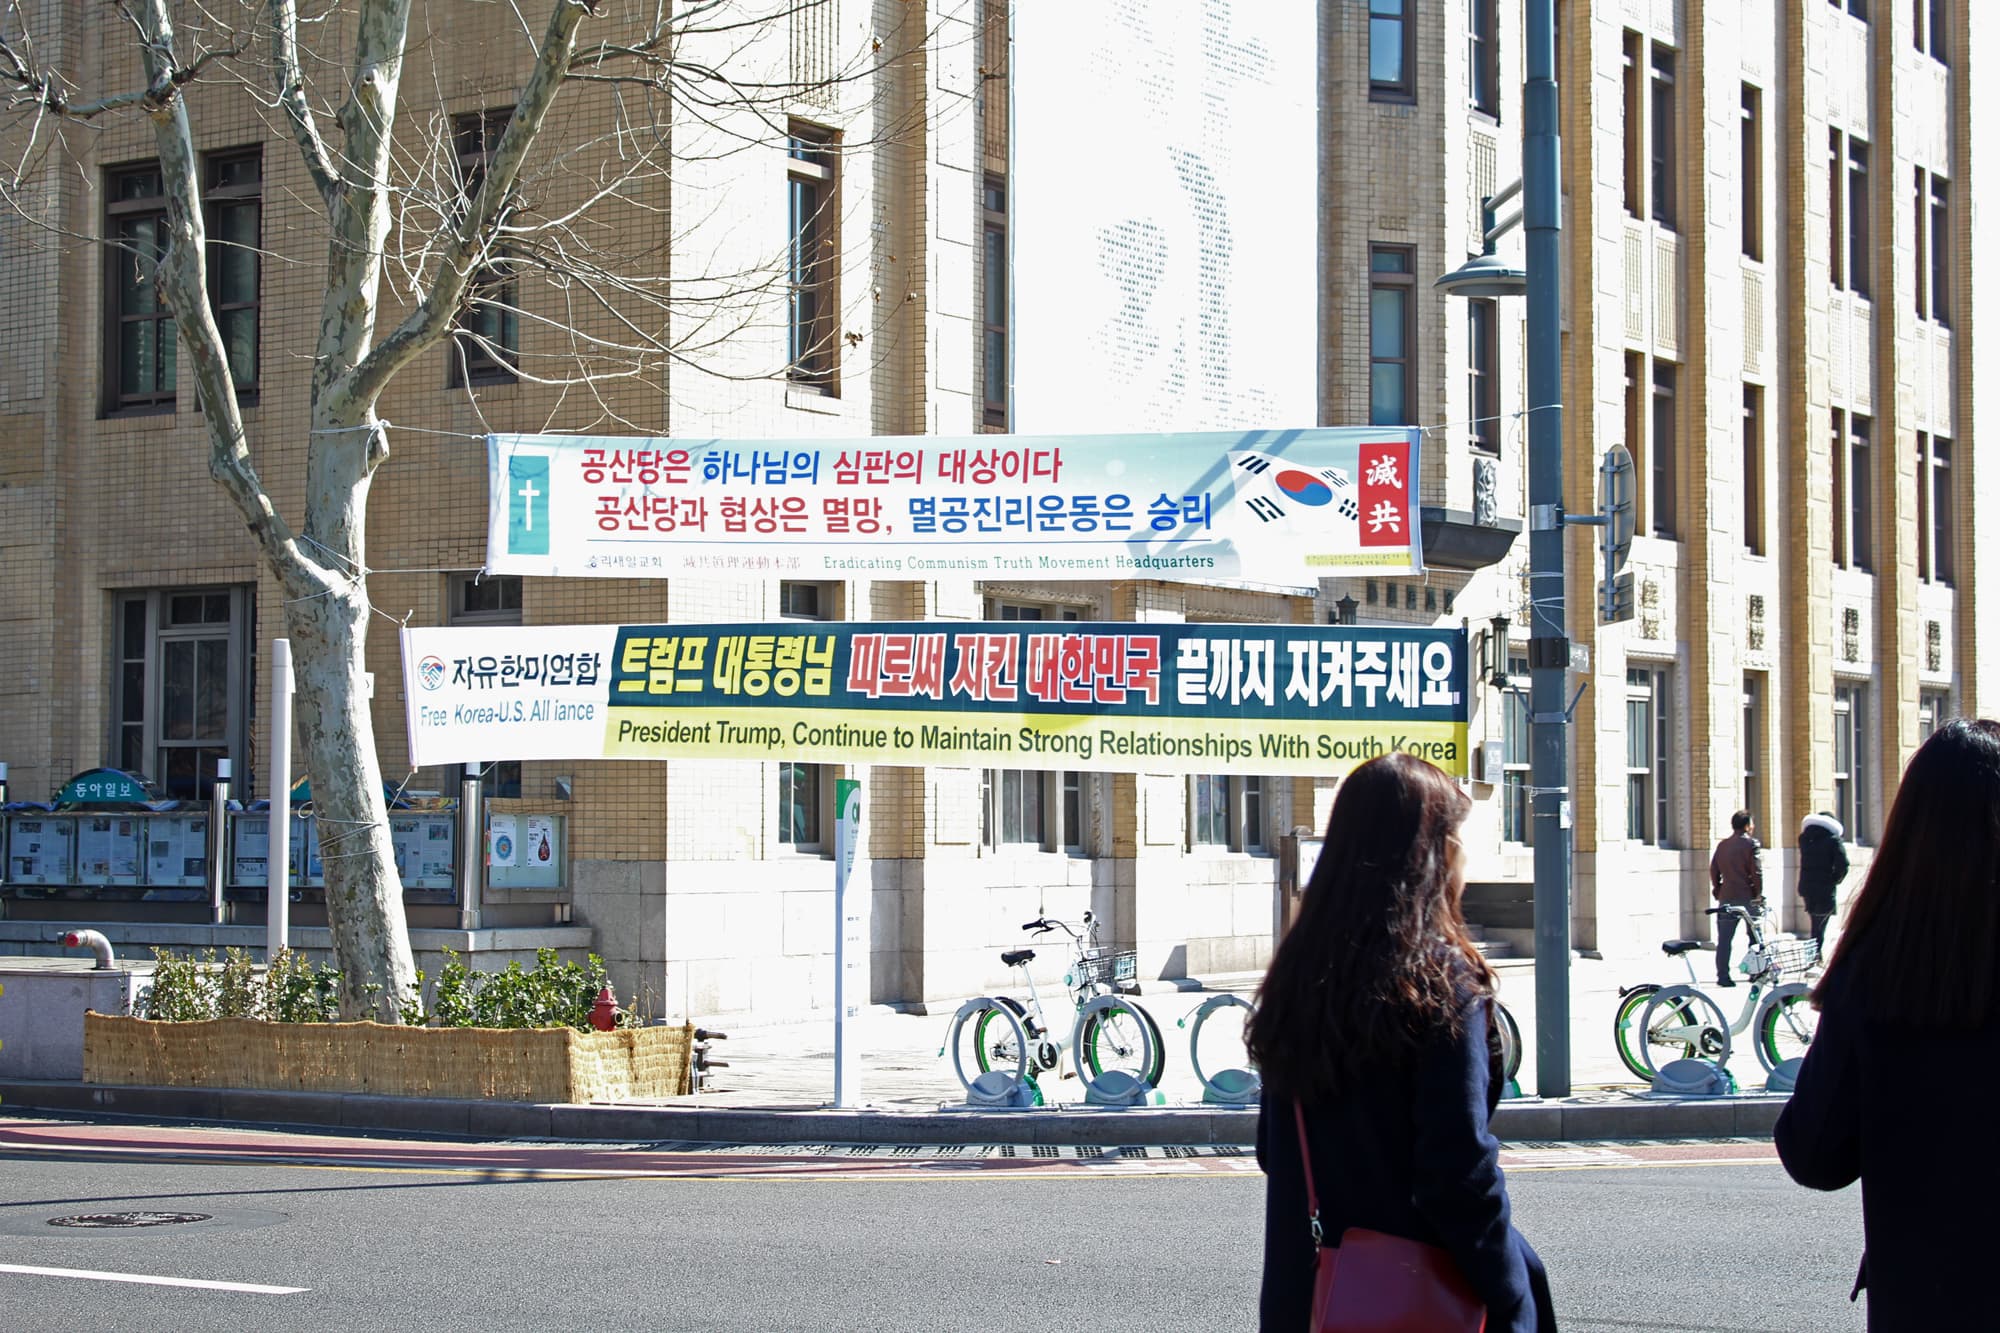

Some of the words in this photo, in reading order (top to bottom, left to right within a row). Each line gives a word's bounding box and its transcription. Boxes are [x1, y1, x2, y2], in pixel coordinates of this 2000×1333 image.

[581, 449, 690, 484] 공산당은
[703, 449, 820, 485] 하나님의
[833, 449, 923, 485] 심판의
[938, 447, 1063, 484] 대상이다
[595, 496, 708, 533] 공산당과
[720, 496, 808, 533] 협상은
[823, 497, 893, 535] 멸망,
[909, 494, 1134, 533] 멸공진리운동은
[1147, 491, 1212, 531] 승리
[585, 554, 662, 569] 승리새일교회
[824, 556, 902, 572] Eradicating
[907, 556, 989, 570] Communism
[994, 556, 1033, 570] Truth
[1039, 555, 1110, 569] Movement
[1116, 554, 1214, 571] Headquarters
[452, 652, 602, 691] 자유한미연합
[618, 636, 709, 695] 트럼프
[713, 635, 836, 697] 대통령님
[847, 633, 947, 700] 피로써
[949, 633, 1020, 701] 지킨
[1025, 634, 1161, 705] 대한민국
[1176, 638, 1275, 707] 끝까지
[1284, 640, 1459, 709] 지켜주세요
[420, 705, 447, 727] Free
[454, 700, 527, 725] Korea-U.S.
[618, 720, 711, 743] President
[717, 721, 785, 750] Trump,
[793, 721, 887, 748] Continue
[894, 726, 914, 748] to
[921, 725, 1012, 752] Maintain
[1018, 727, 1092, 760] Strong
[1101, 729, 1252, 763] Relationships
[1259, 733, 1310, 759] With
[1317, 734, 1383, 760] South
[75, 782, 132, 798] 동아일보
